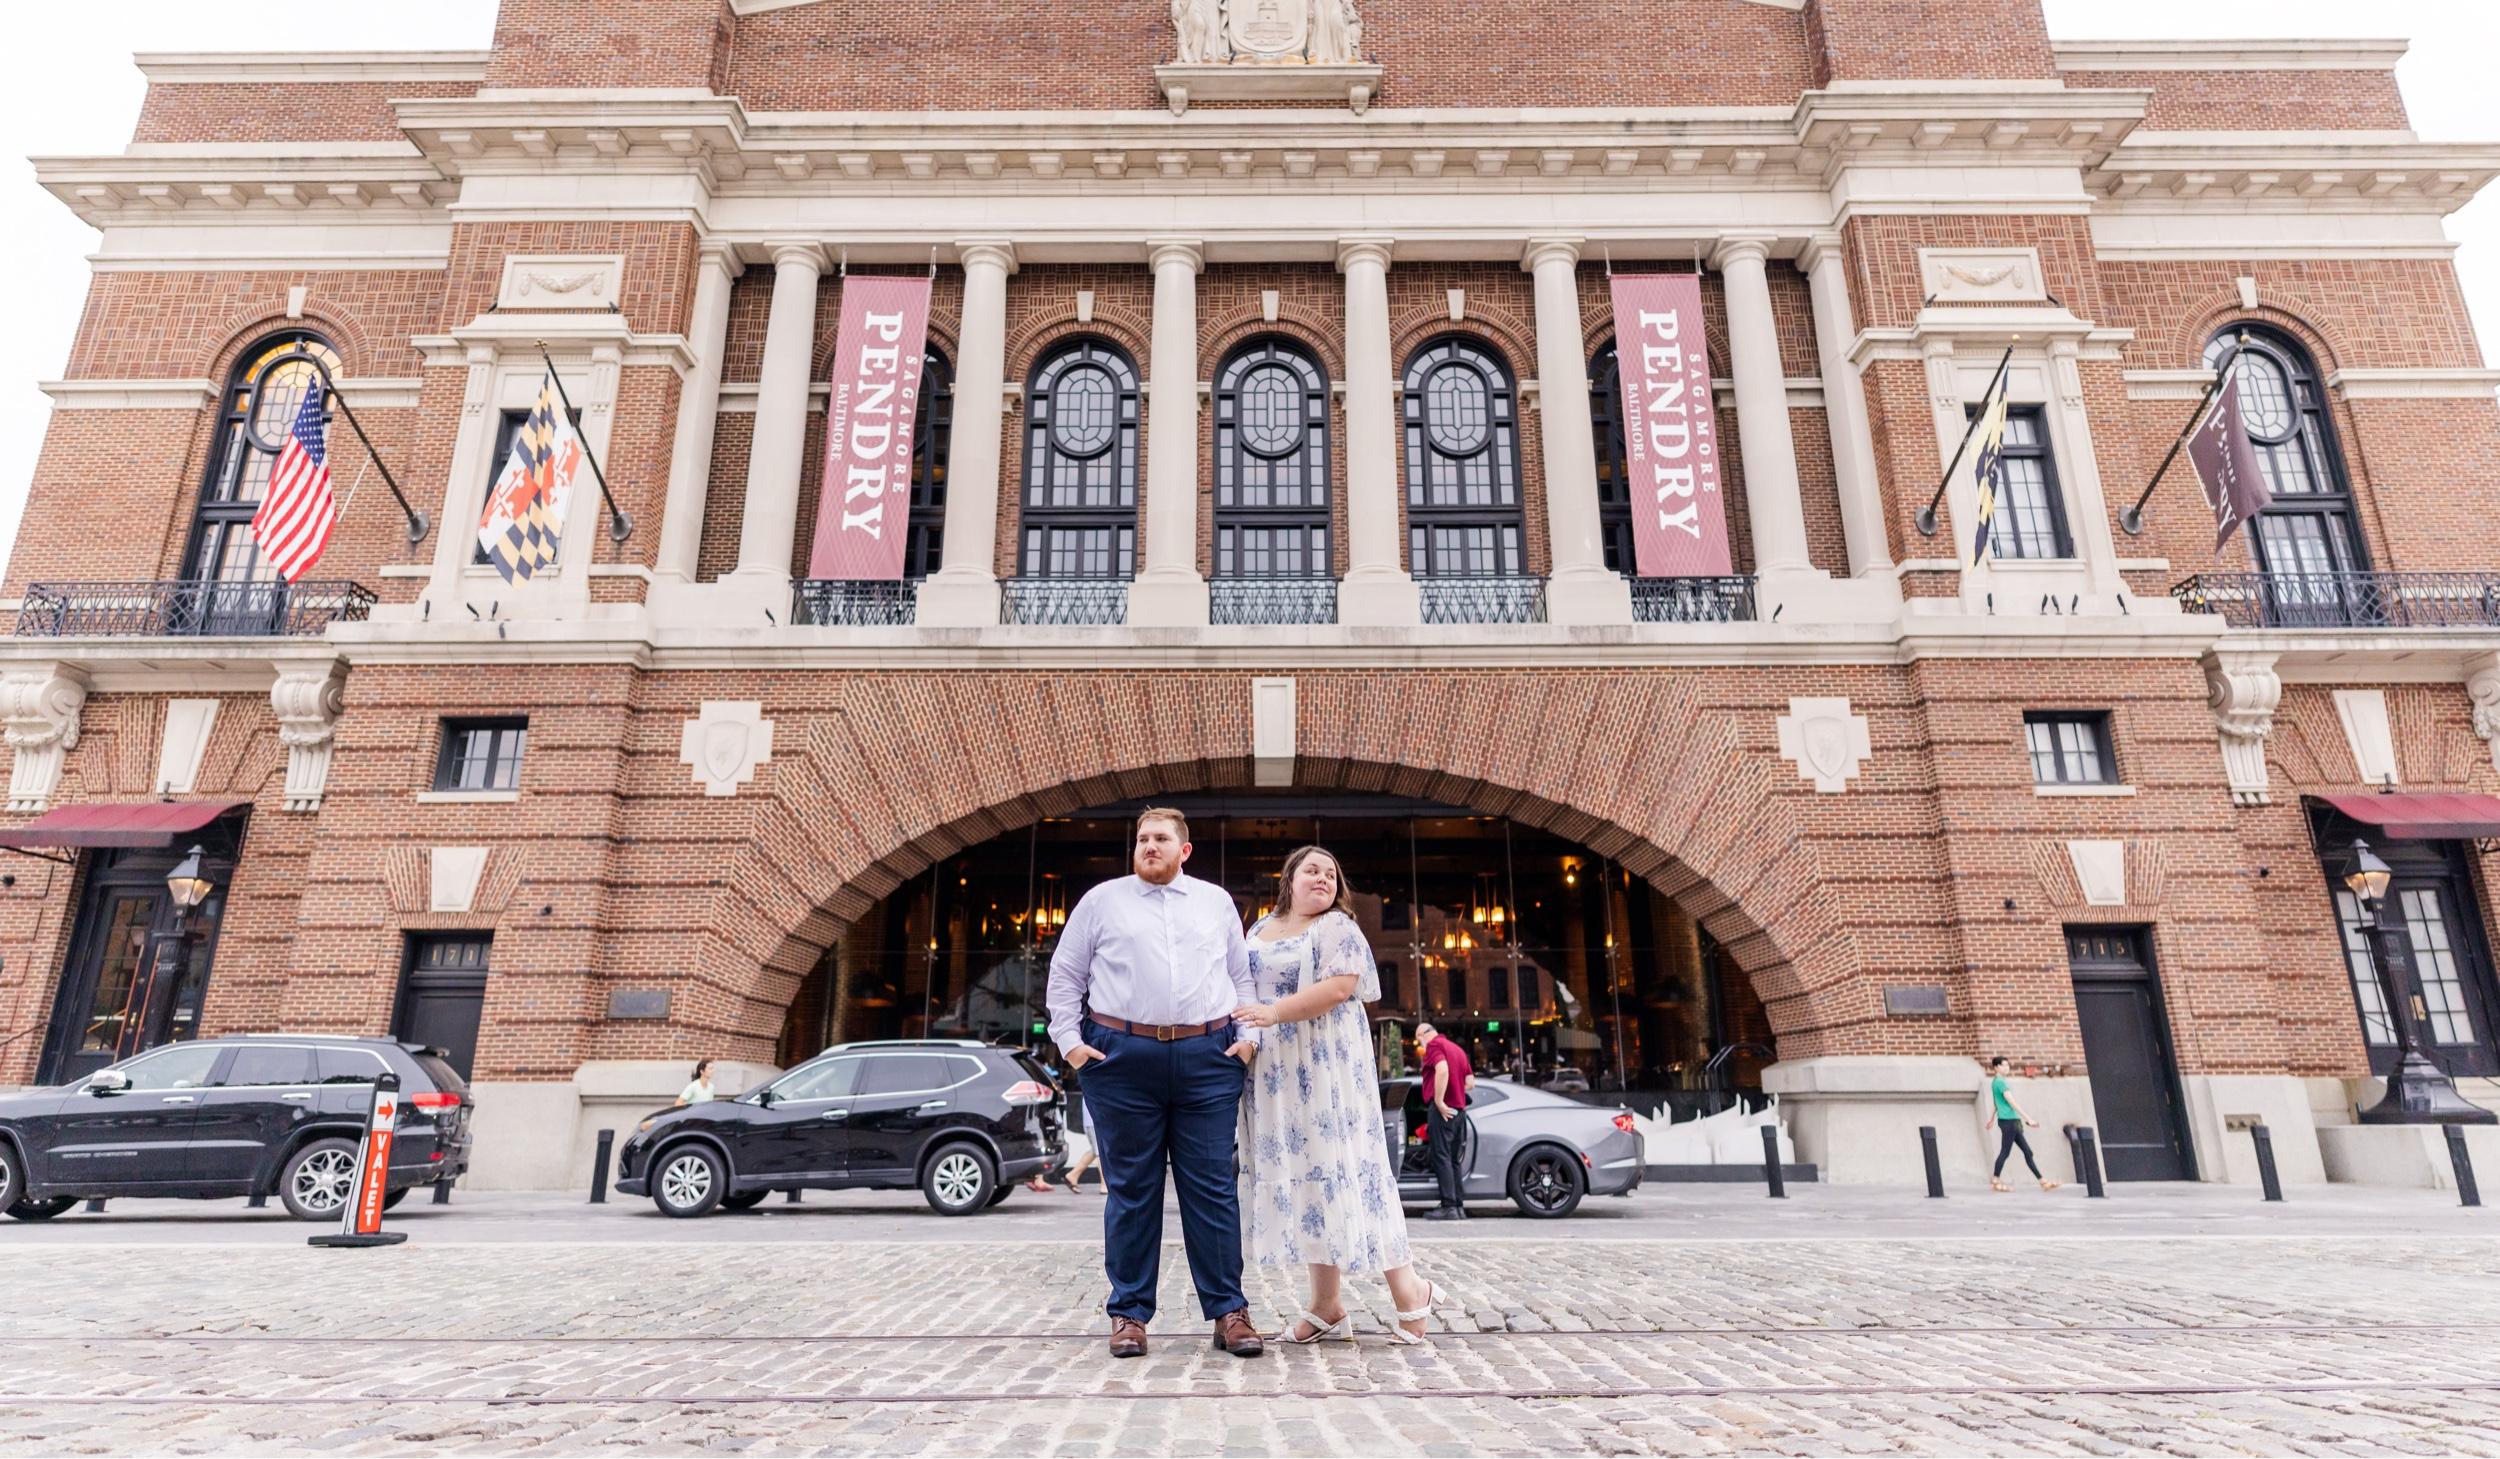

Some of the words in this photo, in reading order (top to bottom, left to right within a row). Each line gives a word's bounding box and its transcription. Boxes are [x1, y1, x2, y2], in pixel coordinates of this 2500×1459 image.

[830, 383, 850, 462] BALTIMORE
[841, 310, 904, 541] PENDRY
[892, 354, 918, 493] SAGAMORE
[1627, 382, 1646, 462] BALTIMORE
[1639, 308, 1701, 539] PENDRY
[1689, 353, 1716, 493] SAGAMORE
[365, 1134, 388, 1226] VALET
